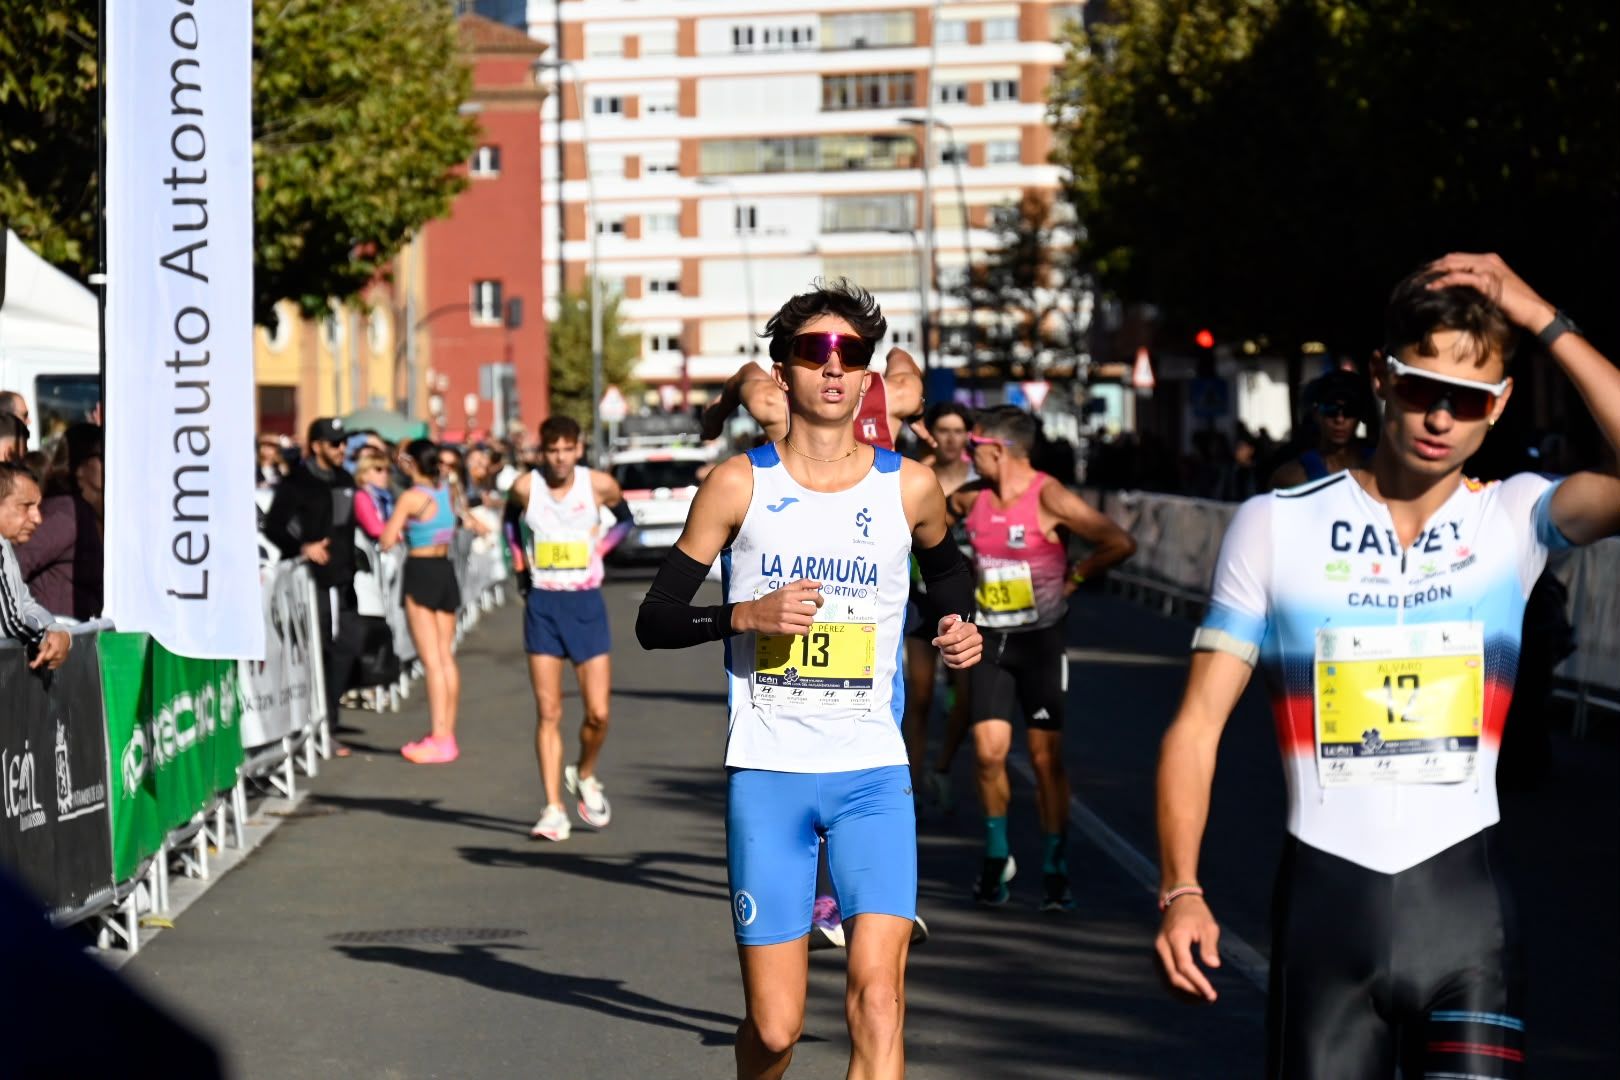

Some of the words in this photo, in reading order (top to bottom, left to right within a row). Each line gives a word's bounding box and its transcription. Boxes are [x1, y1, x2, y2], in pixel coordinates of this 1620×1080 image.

[159, 0, 210, 283] Automo
[164, 305, 210, 601] Lemauto
[761, 553, 783, 577] LA
[790, 555, 878, 587] ARMUÑA
[1348, 584, 1453, 609] CALDERÓN
[818, 624, 845, 633] PÉREZ
[802, 632, 830, 668] 13
[1383, 674, 1423, 724] 12
